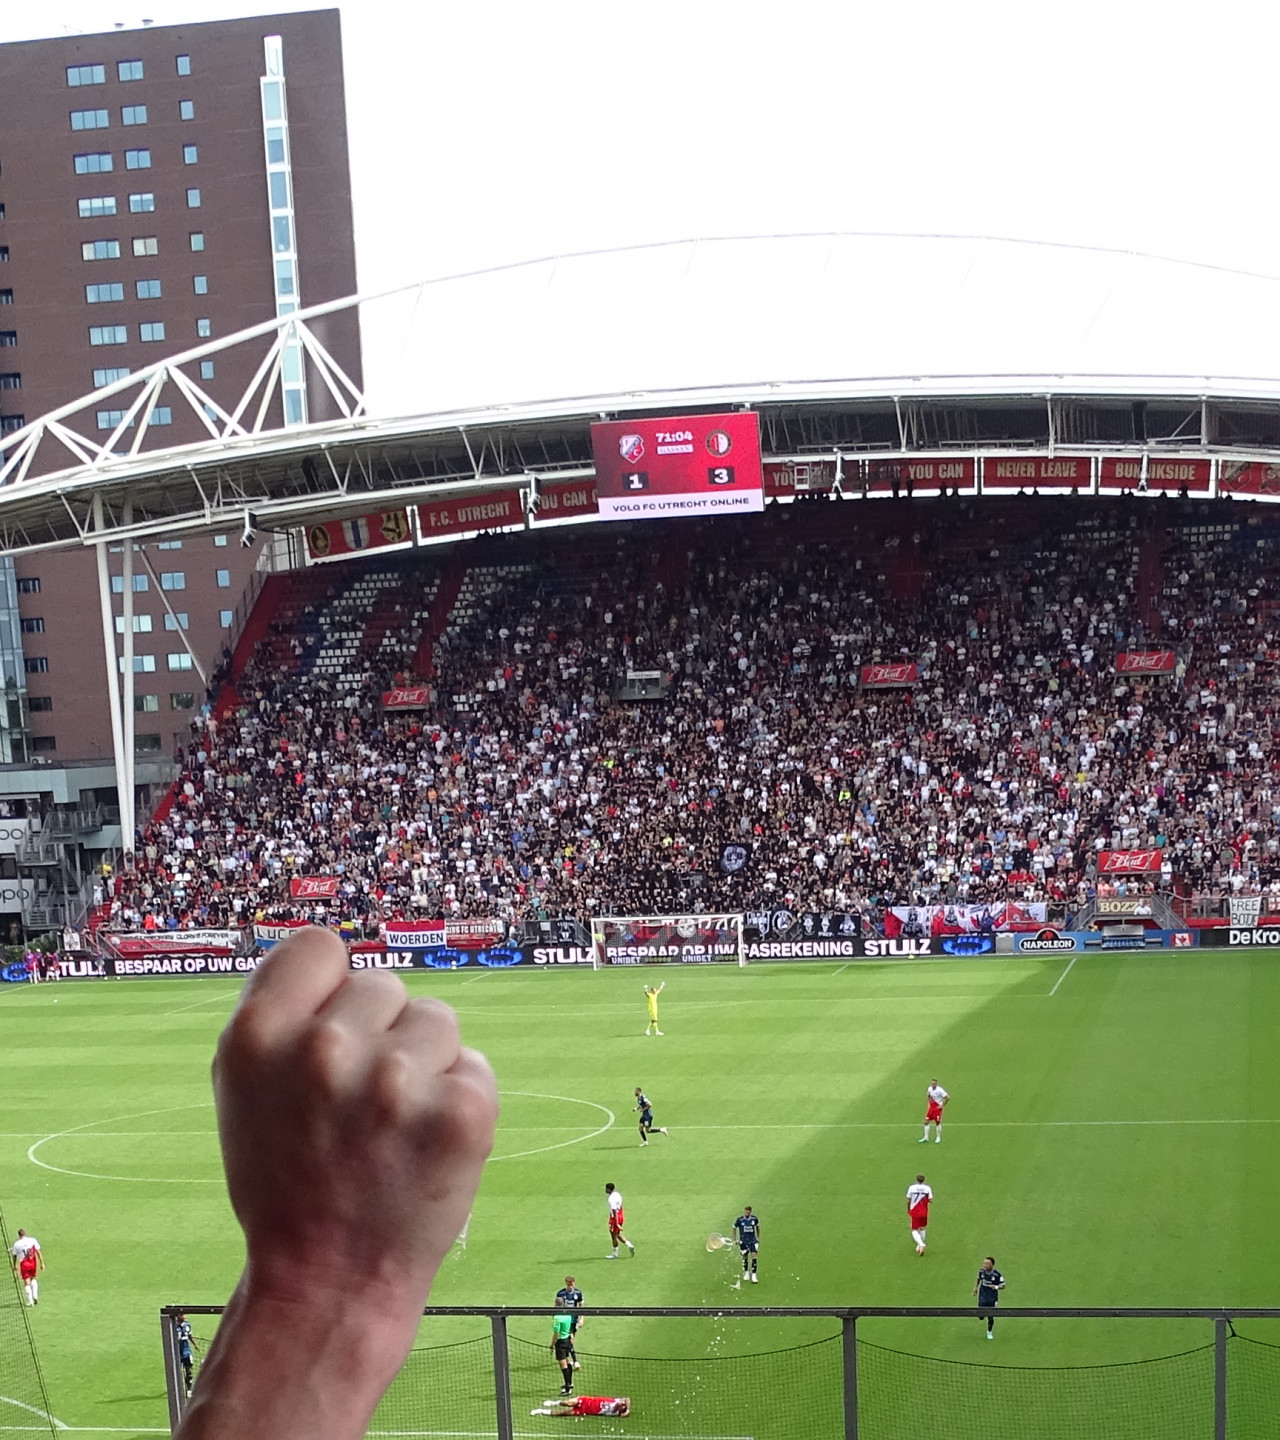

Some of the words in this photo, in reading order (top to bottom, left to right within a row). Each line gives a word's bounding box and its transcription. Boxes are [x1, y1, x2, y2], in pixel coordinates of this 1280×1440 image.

[656, 431, 693, 443] 71:04
[714, 468, 729, 484] 3
[909, 466, 933, 479] YOU
[939, 464, 963, 479] CAN
[997, 463, 1035, 478] NEVER
[1041, 462, 1076, 478] LEAVE
[1115, 463, 1196, 480] BUNIKSIDE
[629, 473, 643, 489] 1
[563, 492, 587, 507] CAN
[613, 504, 641, 513] VOLG
[643, 502, 656, 511] FC
[658, 499, 708, 510] UTRECHT
[710, 497, 750, 507] ONLINE
[430, 511, 453, 527] F.C.
[458, 501, 510, 522] UTRECHT
[1136, 656, 1156, 668] Bud
[878, 668, 900, 679] Bud
[397, 690, 418, 702] Bud
[1115, 854, 1142, 867] Bud
[307, 881, 329, 893] Bud
[1231, 899, 1259, 911] FREE
[389, 932, 444, 945] WOERDEN
[1022, 938, 1073, 949] NAPOLEON
[534, 947, 594, 963] STULZ
[864, 939, 931, 956] STULZ
[115, 959, 182, 974] BESPAAR
[184, 958, 206, 972] OP
[208, 957, 232, 972] UW
[352, 952, 413, 968] STULZ
[611, 956, 640, 965] UNIBET
[682, 954, 711, 963] UNIBET
